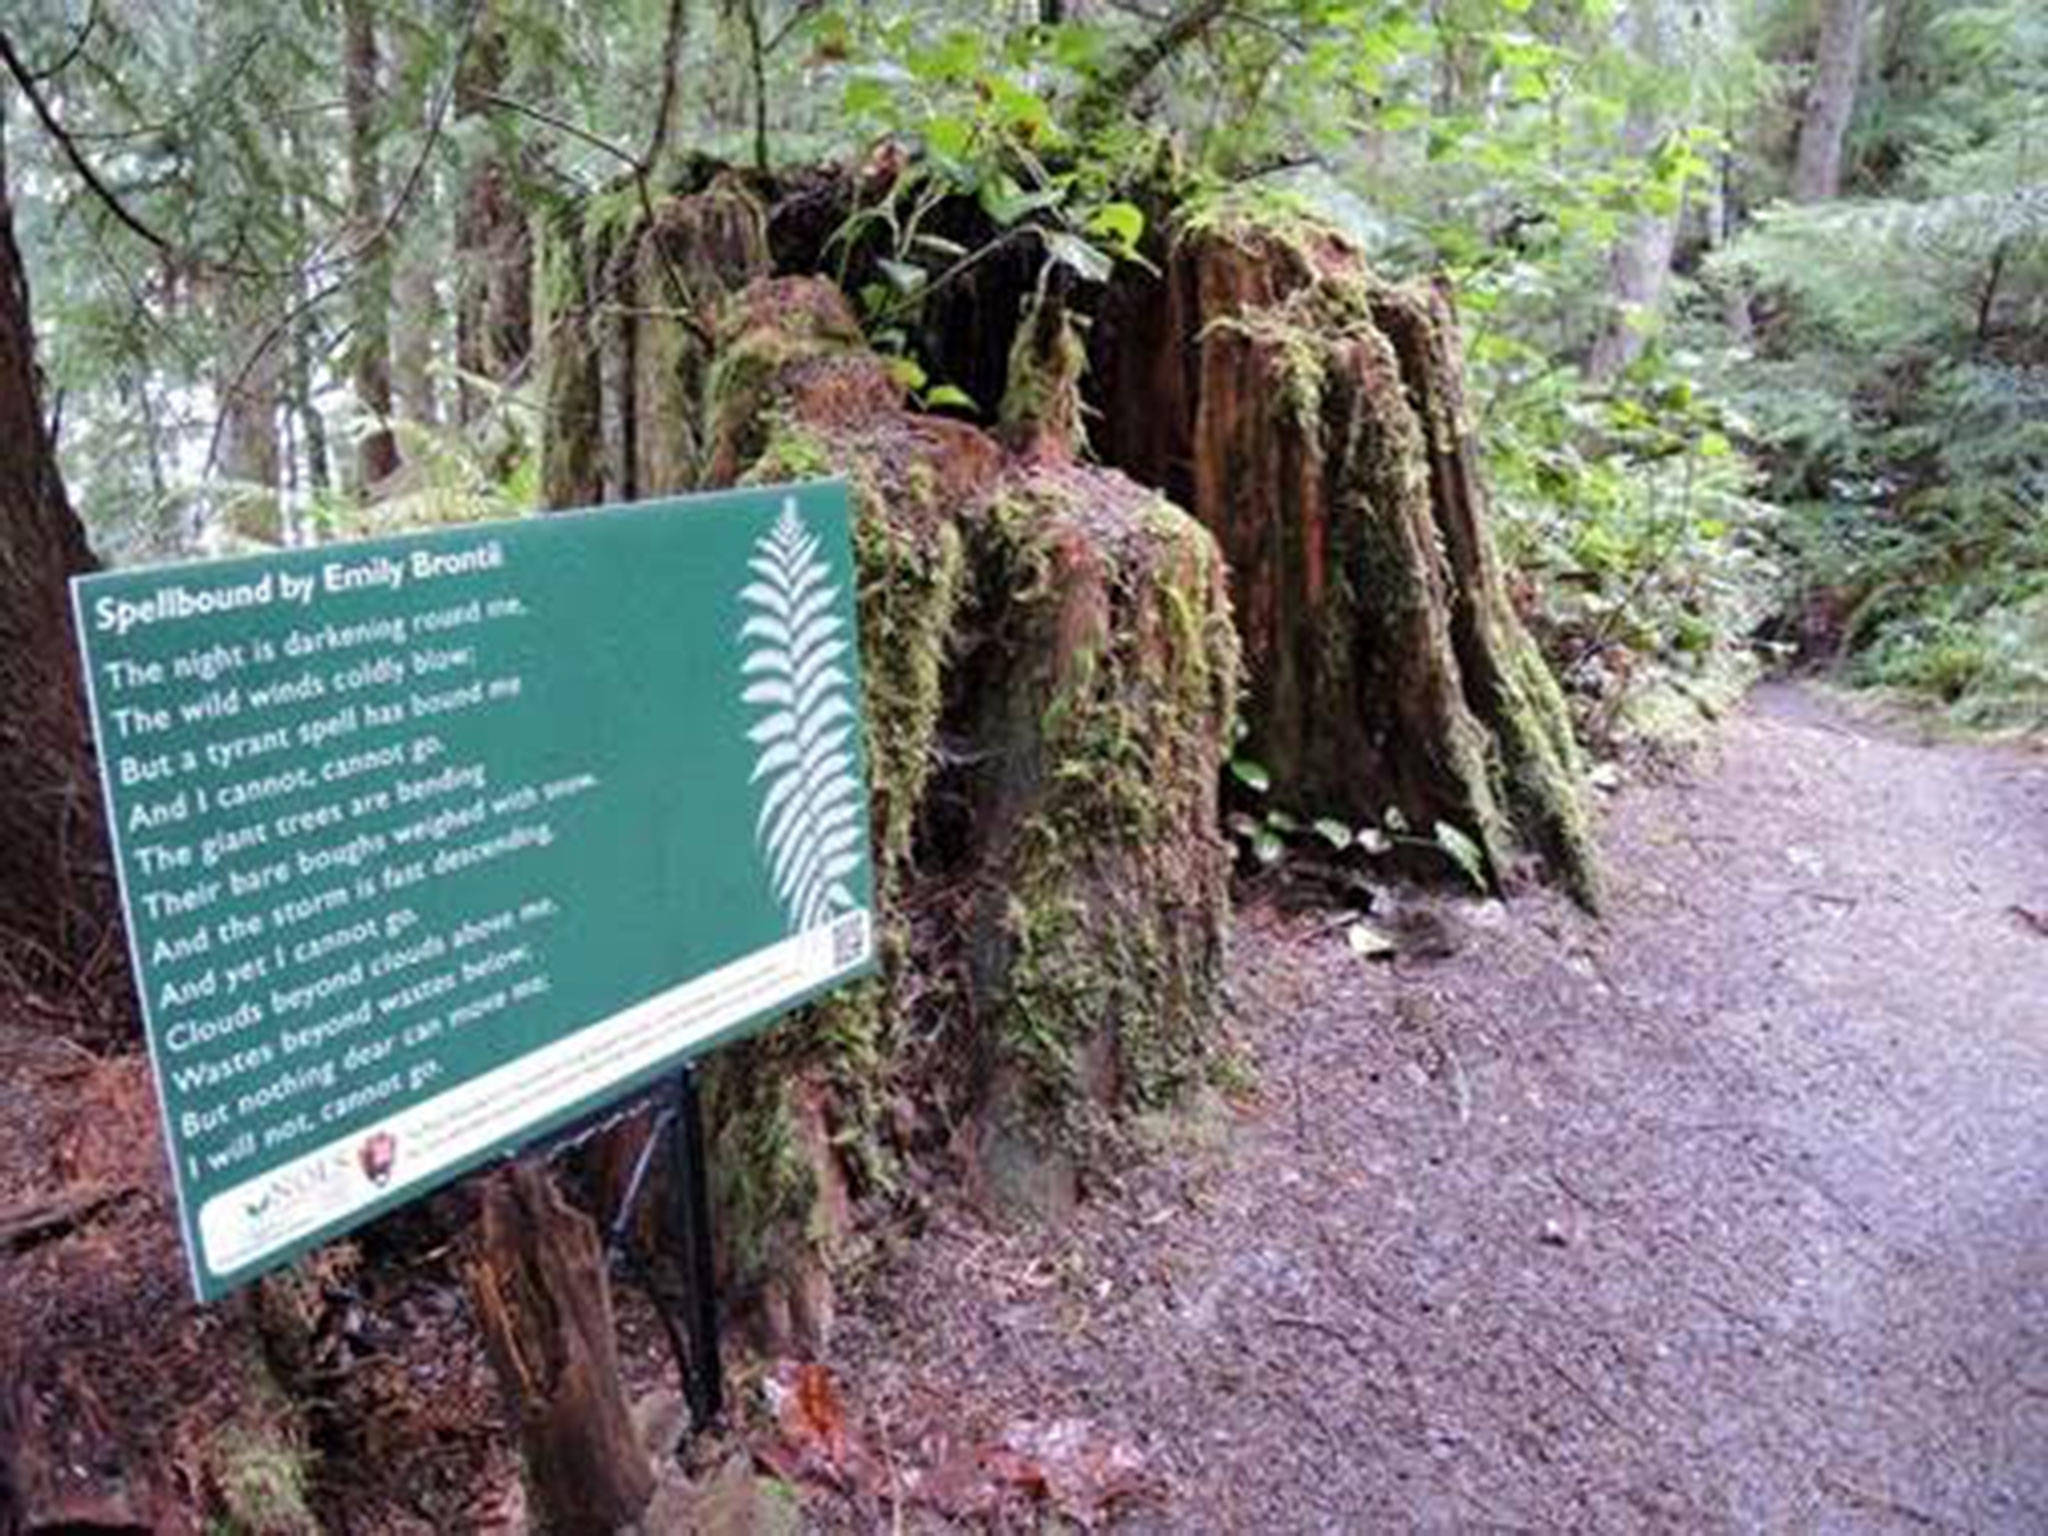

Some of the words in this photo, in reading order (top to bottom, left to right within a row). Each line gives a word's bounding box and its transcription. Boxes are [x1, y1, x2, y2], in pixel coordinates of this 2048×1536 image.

[96, 572, 272, 635] Spellbound
[280, 572, 315, 604] by
[323, 556, 404, 591] Emily
[104, 660, 163, 690] The
[174, 644, 244, 682] night
[255, 639, 274, 661] is
[284, 617, 406, 656] darkening
[413, 601, 480, 634] round
[110, 706, 170, 738] The
[180, 688, 239, 722] wild
[251, 672, 325, 707] winds
[333, 656, 404, 692] coldly
[120, 756, 173, 786] But
[181, 751, 197, 771] a
[206, 727, 290, 770] tyrant
[298, 706, 357, 748] spell
[364, 703, 403, 726] has
[410, 680, 482, 716] bound
[129, 790, 188, 833] And
[196, 786, 208, 814] I
[321, 743, 404, 782] cannot
[133, 844, 191, 875] The
[201, 823, 268, 868] giant
[275, 803, 343, 837] trees
[351, 791, 390, 817] are
[395, 762, 485, 803] bending
[142, 881, 221, 919] Their
[229, 862, 289, 896] bare
[297, 834, 387, 875] boughs
[392, 797, 485, 844] weighed
[153, 926, 209, 966] And
[218, 916, 262, 944] the
[272, 888, 350, 927] storm
[355, 877, 376, 898] is
[382, 860, 425, 890] fast
[160, 970, 216, 1010] And
[226, 957, 267, 994] yet
[276, 945, 285, 968] I
[294, 918, 379, 962] cannot
[166, 1002, 262, 1052] Clouds
[271, 960, 363, 1014] beyond
[370, 935, 446, 977] clouds
[453, 911, 513, 947] above
[171, 1045, 273, 1092] Wastes
[281, 1000, 371, 1052] beyond
[378, 973, 456, 1013] wastes
[182, 1104, 229, 1138] But
[238, 1060, 335, 1115] nothing
[403, 1018, 442, 1046] can
[188, 1155, 199, 1179] I
[206, 1132, 256, 1170] will
[321, 1073, 402, 1121] cannot
